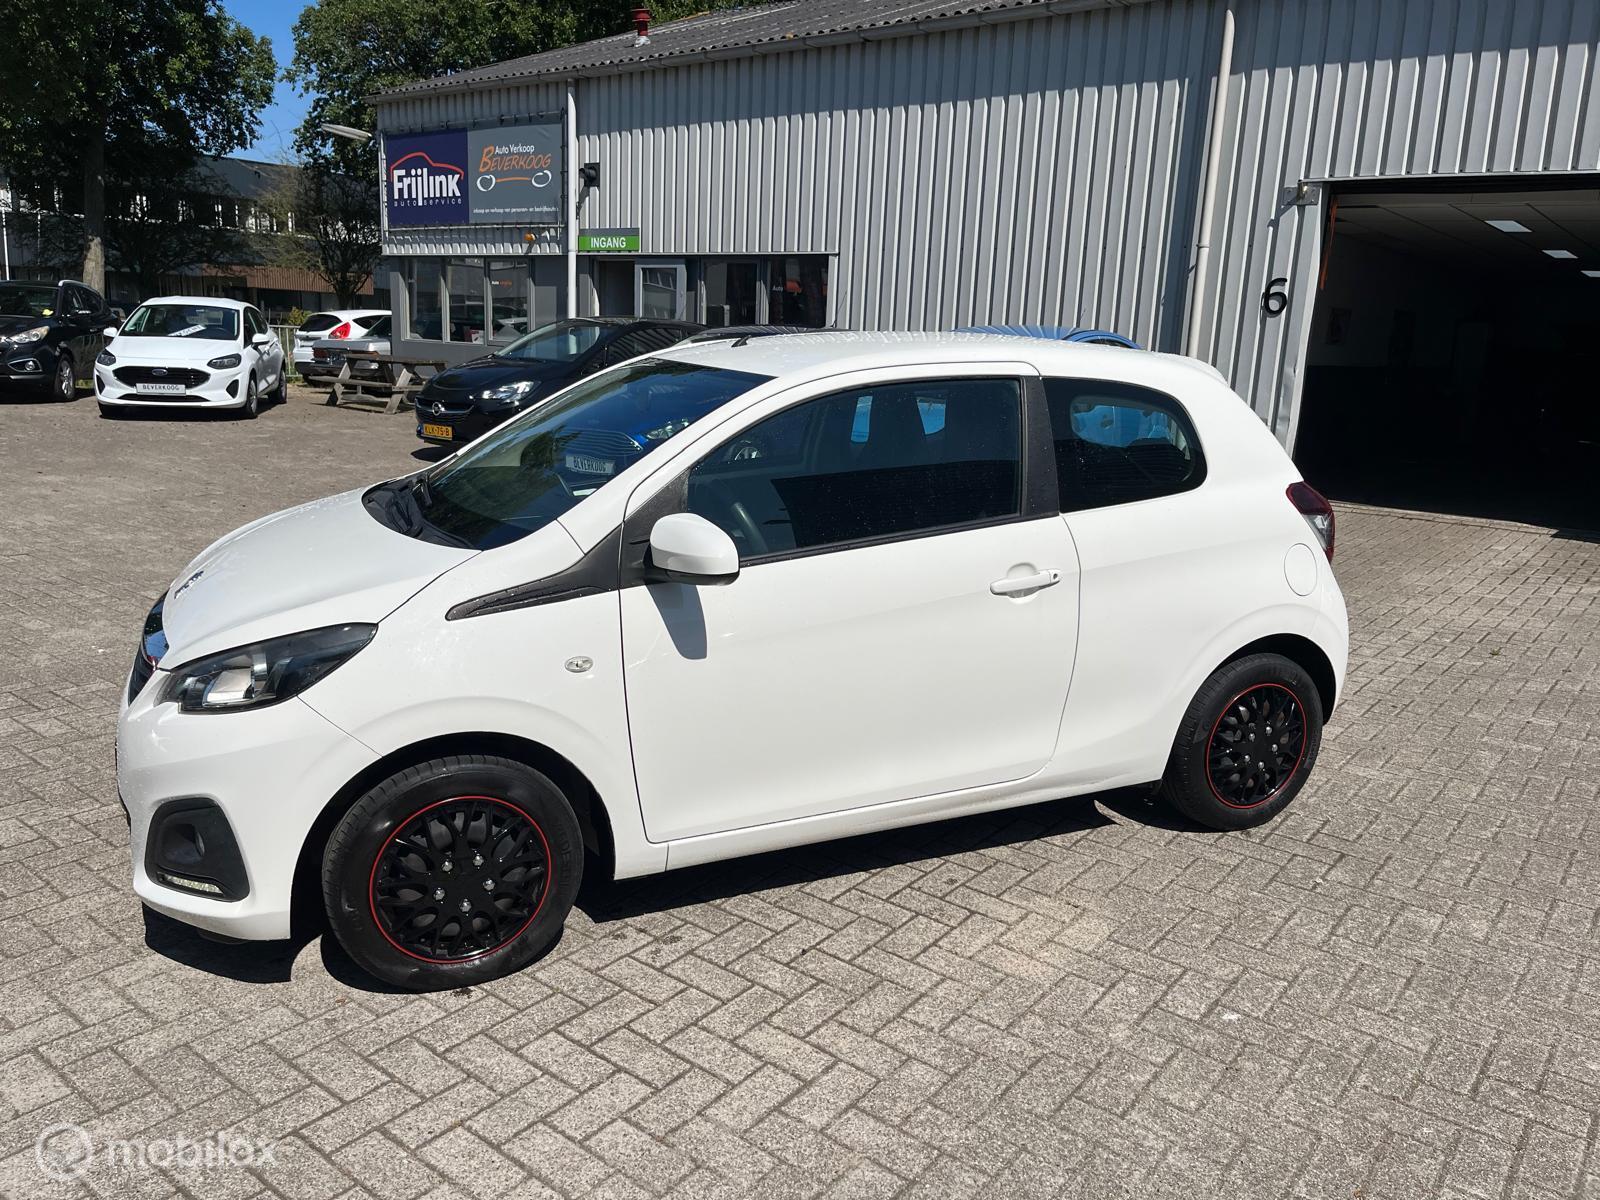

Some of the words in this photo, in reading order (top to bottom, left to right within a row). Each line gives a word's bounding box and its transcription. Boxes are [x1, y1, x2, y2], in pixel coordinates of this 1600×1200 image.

[479, 145, 552, 173] BEVERKOOG
[495, 145, 509, 155] Auto
[509, 143, 535, 154] Verkoop
[590, 236, 626, 249] INGANG
[1264, 277, 1288, 315] 6
